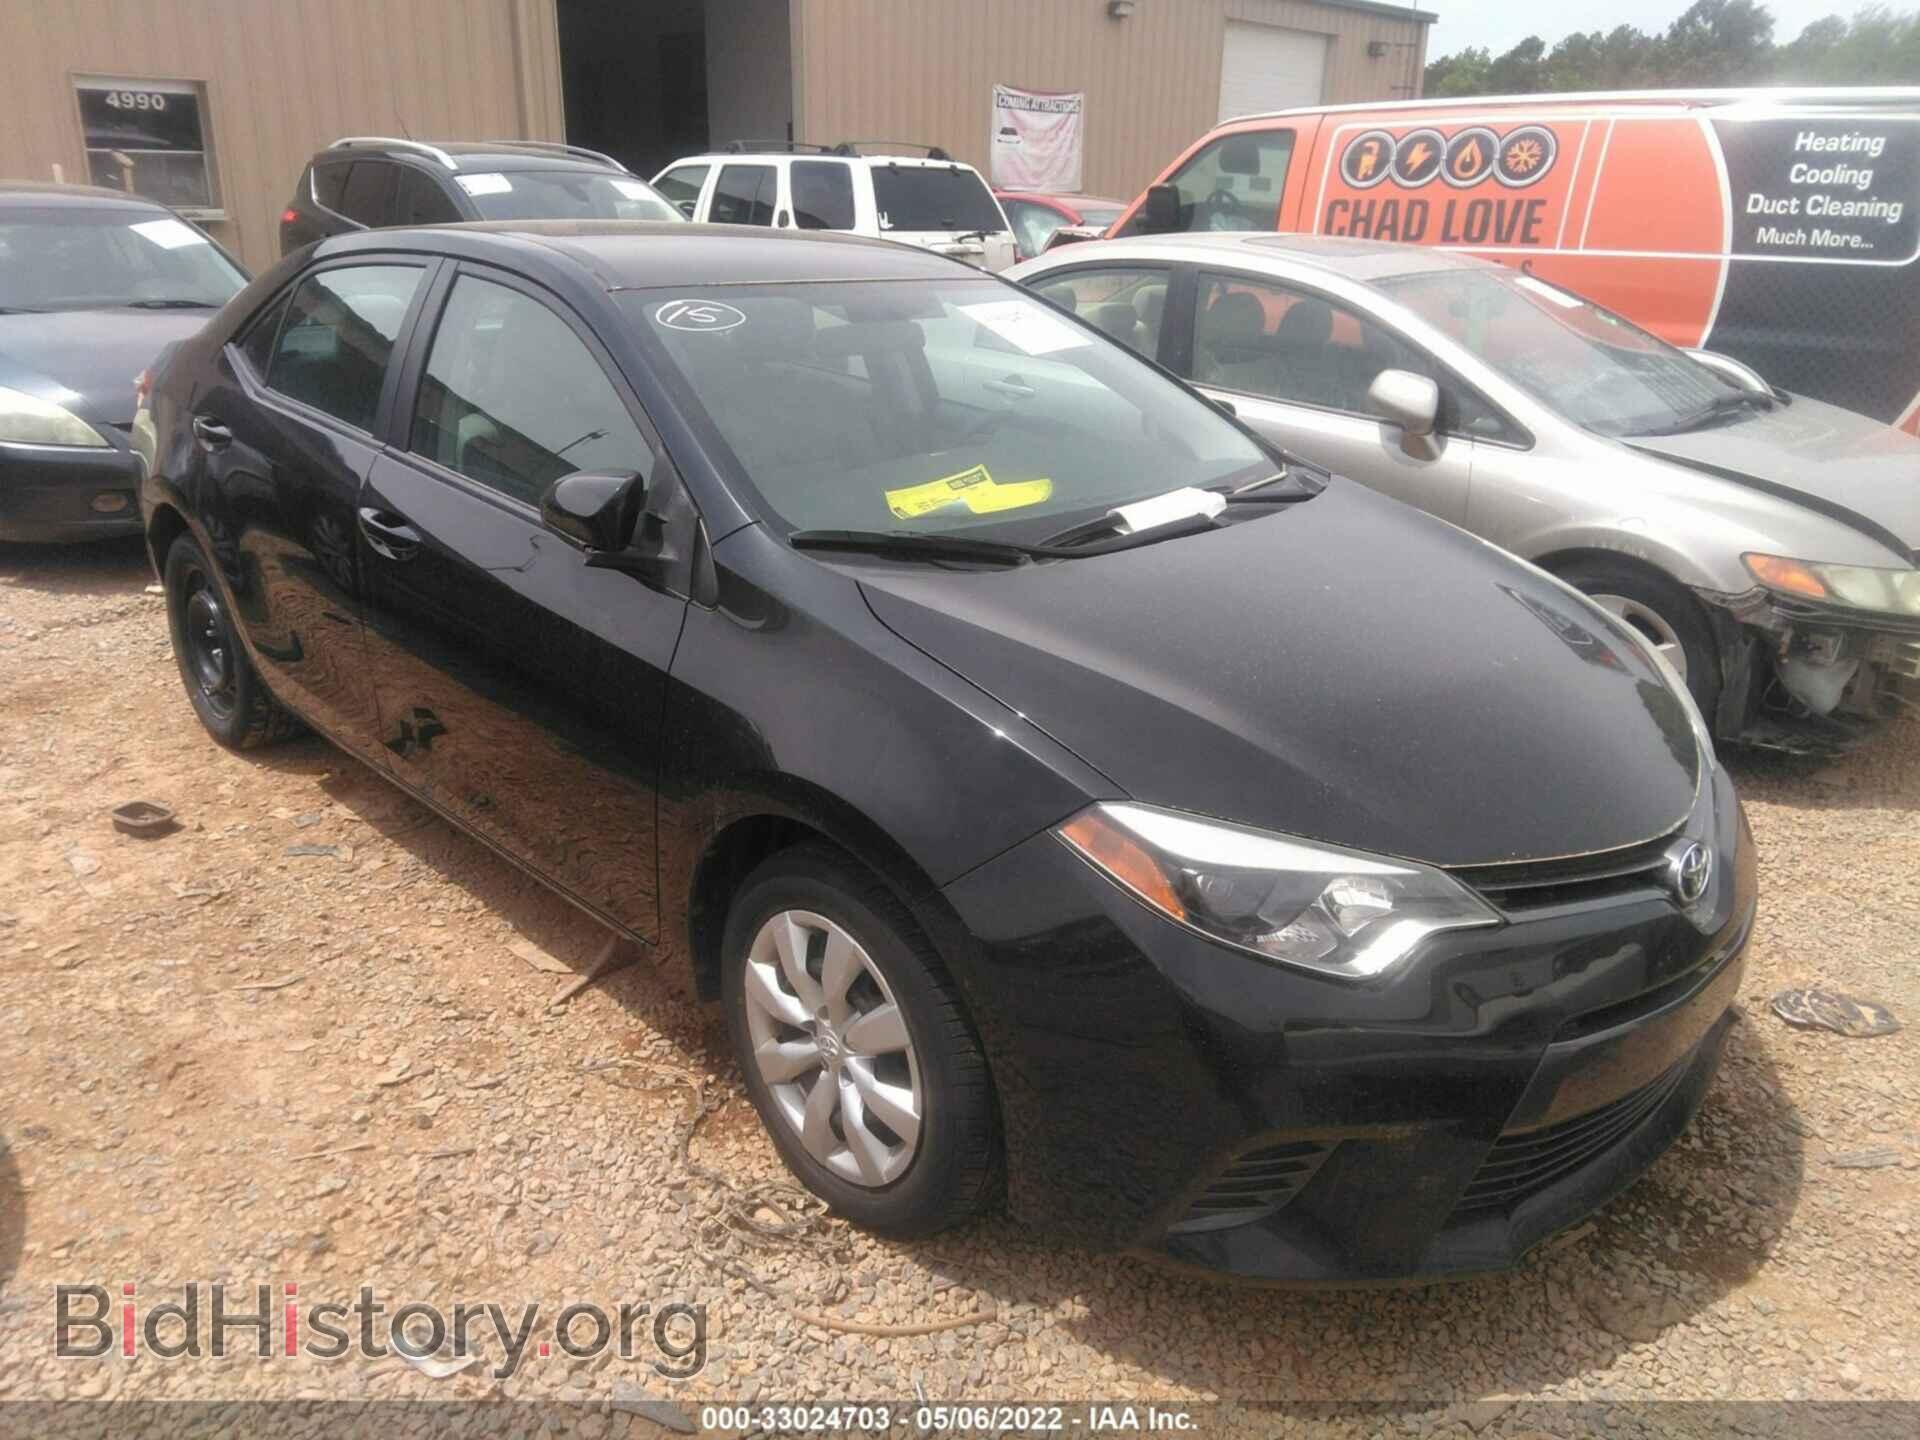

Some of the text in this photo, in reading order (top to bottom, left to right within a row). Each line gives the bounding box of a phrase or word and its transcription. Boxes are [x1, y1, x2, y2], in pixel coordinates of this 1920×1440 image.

[105, 91, 166, 111] 4990
[1795, 131, 1886, 157] Heating
[1789, 163, 1874, 190] Cooling
[1746, 193, 1904, 223] Duct Cleaning
[1324, 199, 1547, 244] CHAD LOVE
[1756, 226, 1874, 249] Much More...
